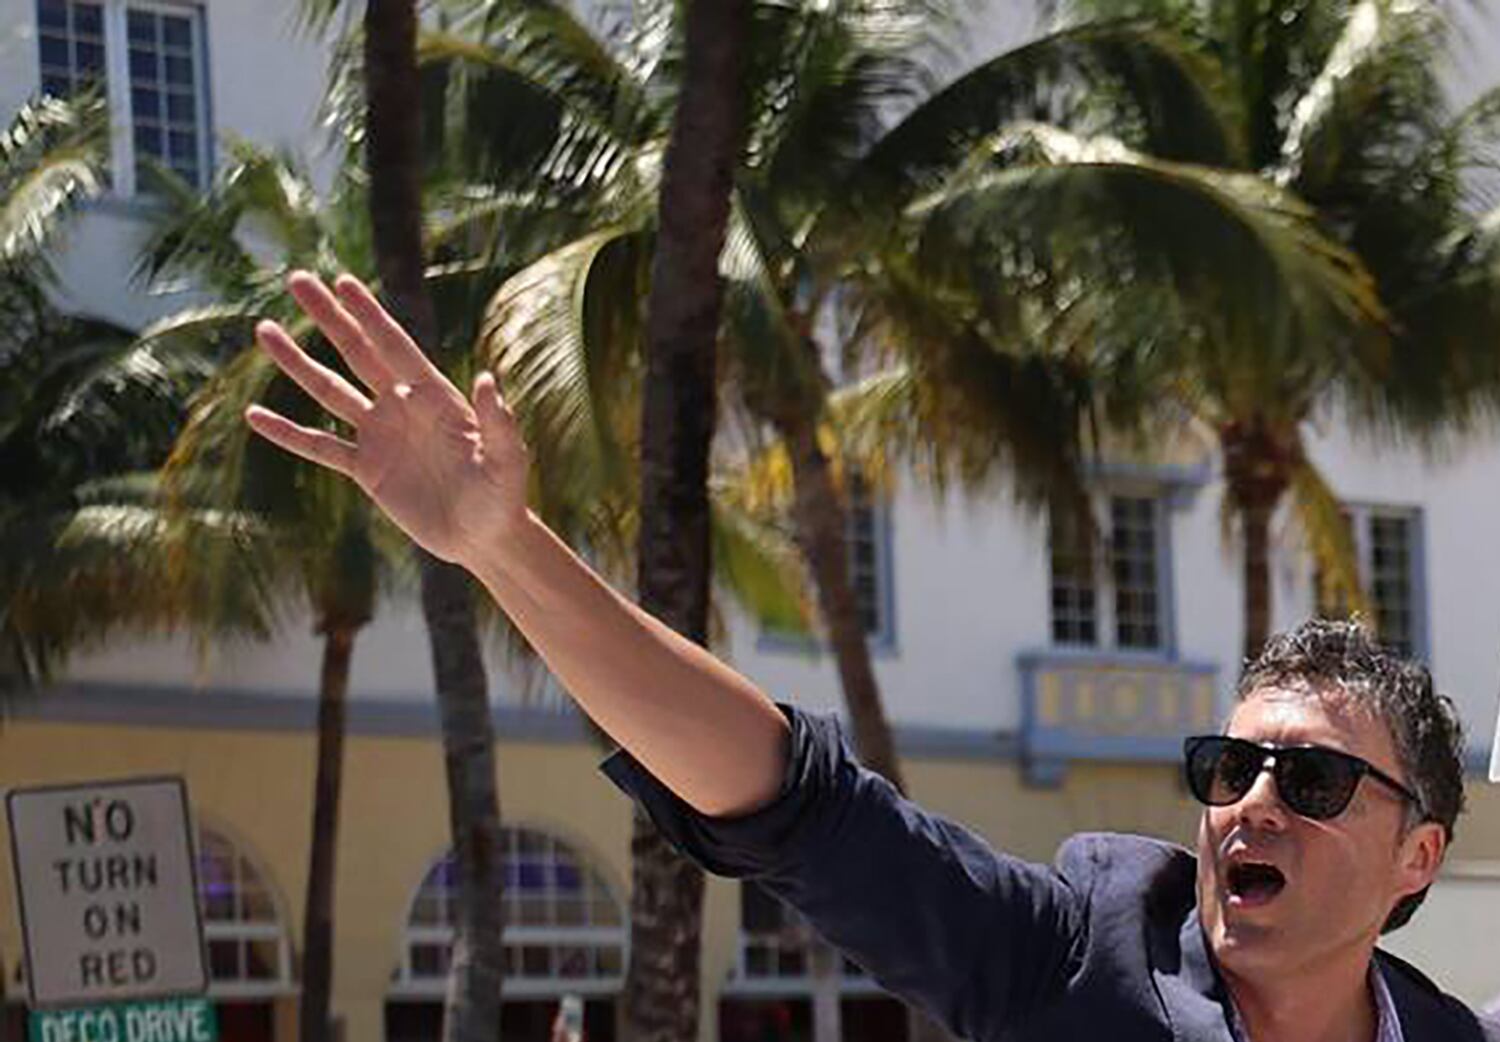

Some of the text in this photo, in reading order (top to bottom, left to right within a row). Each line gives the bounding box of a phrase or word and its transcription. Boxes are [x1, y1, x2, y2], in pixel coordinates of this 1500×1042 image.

[63, 799, 135, 845] NO
[54, 854, 158, 894] TURN
[85, 904, 141, 939] ON
[80, 948, 157, 987] RED
